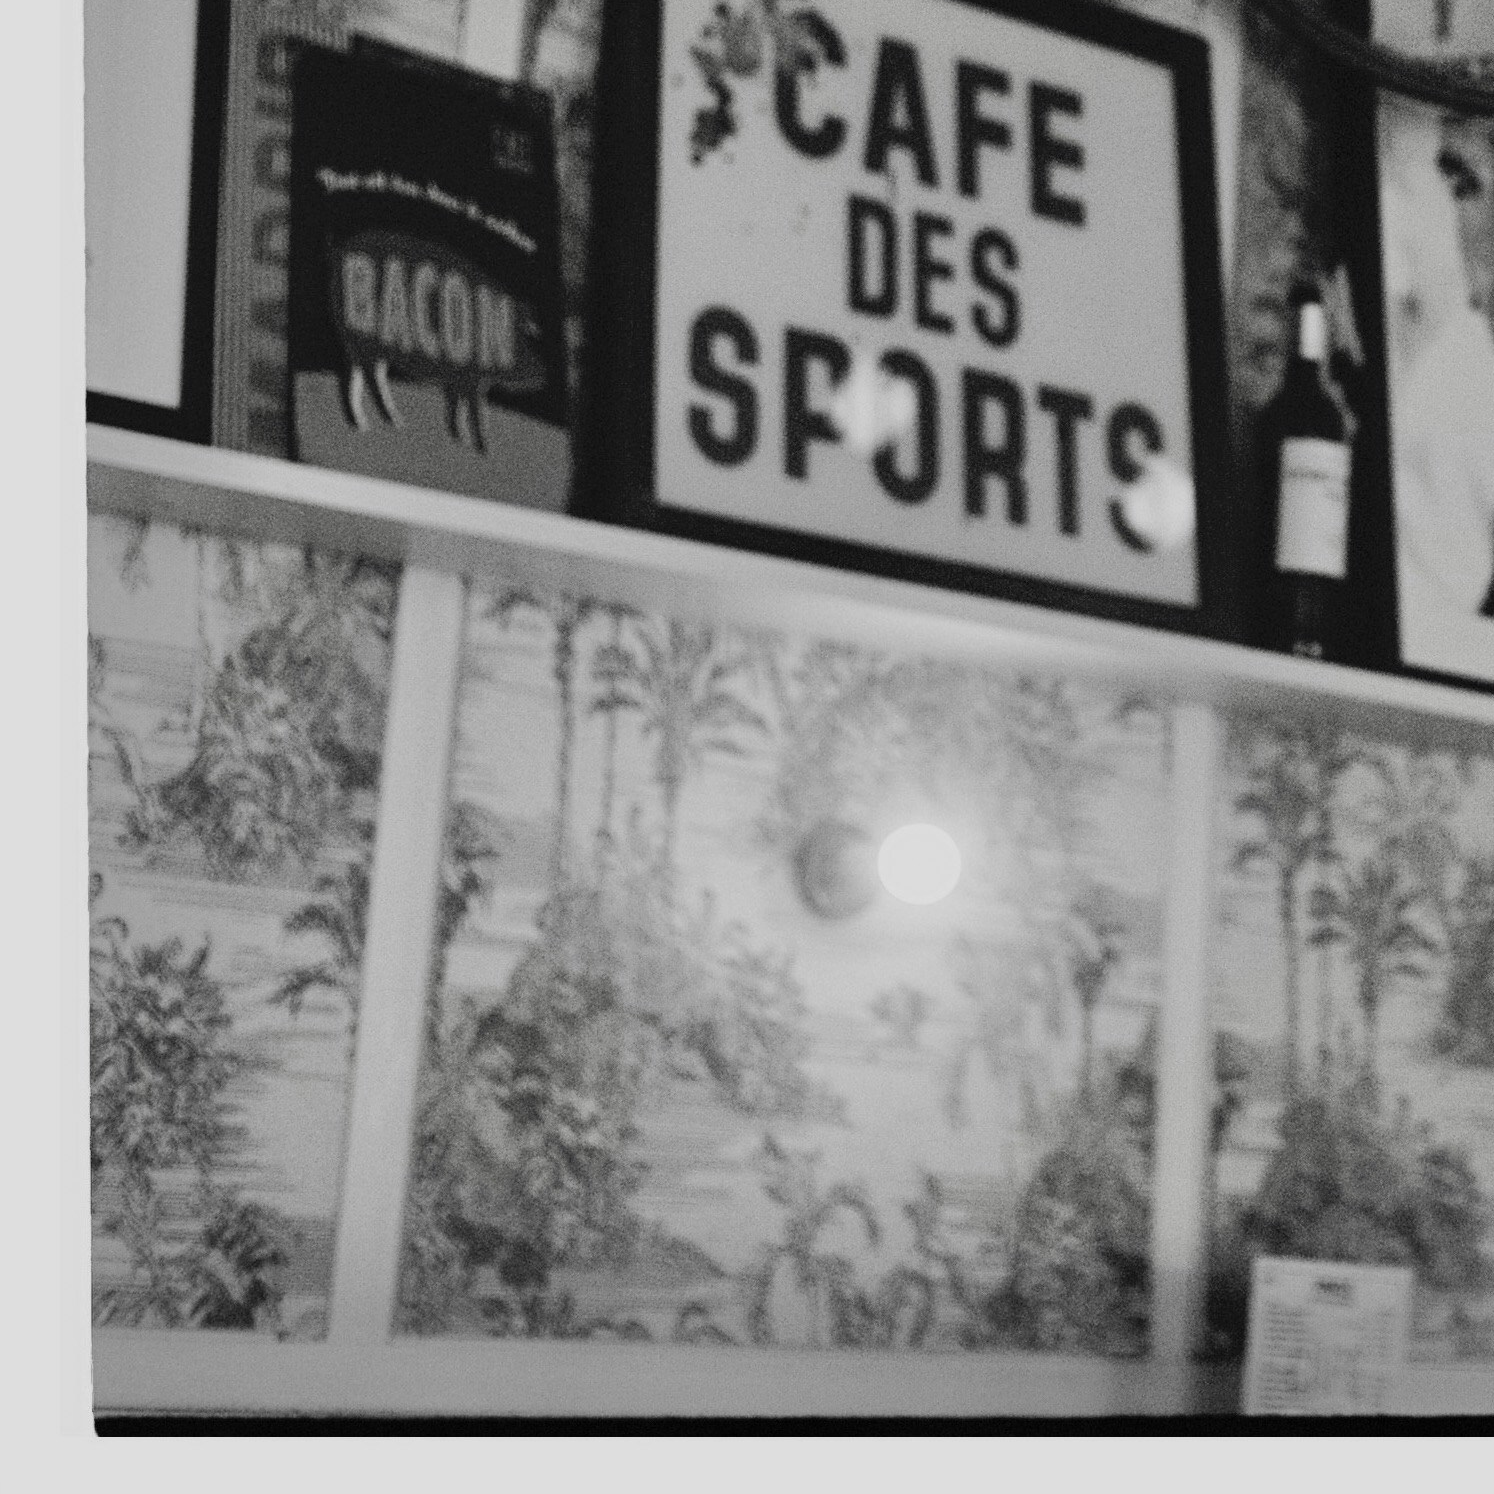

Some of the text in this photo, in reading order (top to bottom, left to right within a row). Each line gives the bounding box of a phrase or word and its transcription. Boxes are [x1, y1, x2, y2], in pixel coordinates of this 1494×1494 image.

[771, 8, 1087, 229] CAFE
[342, 251, 517, 369] BACON
[845, 191, 1022, 349] DES
[686, 304, 1168, 557] SPORTS
